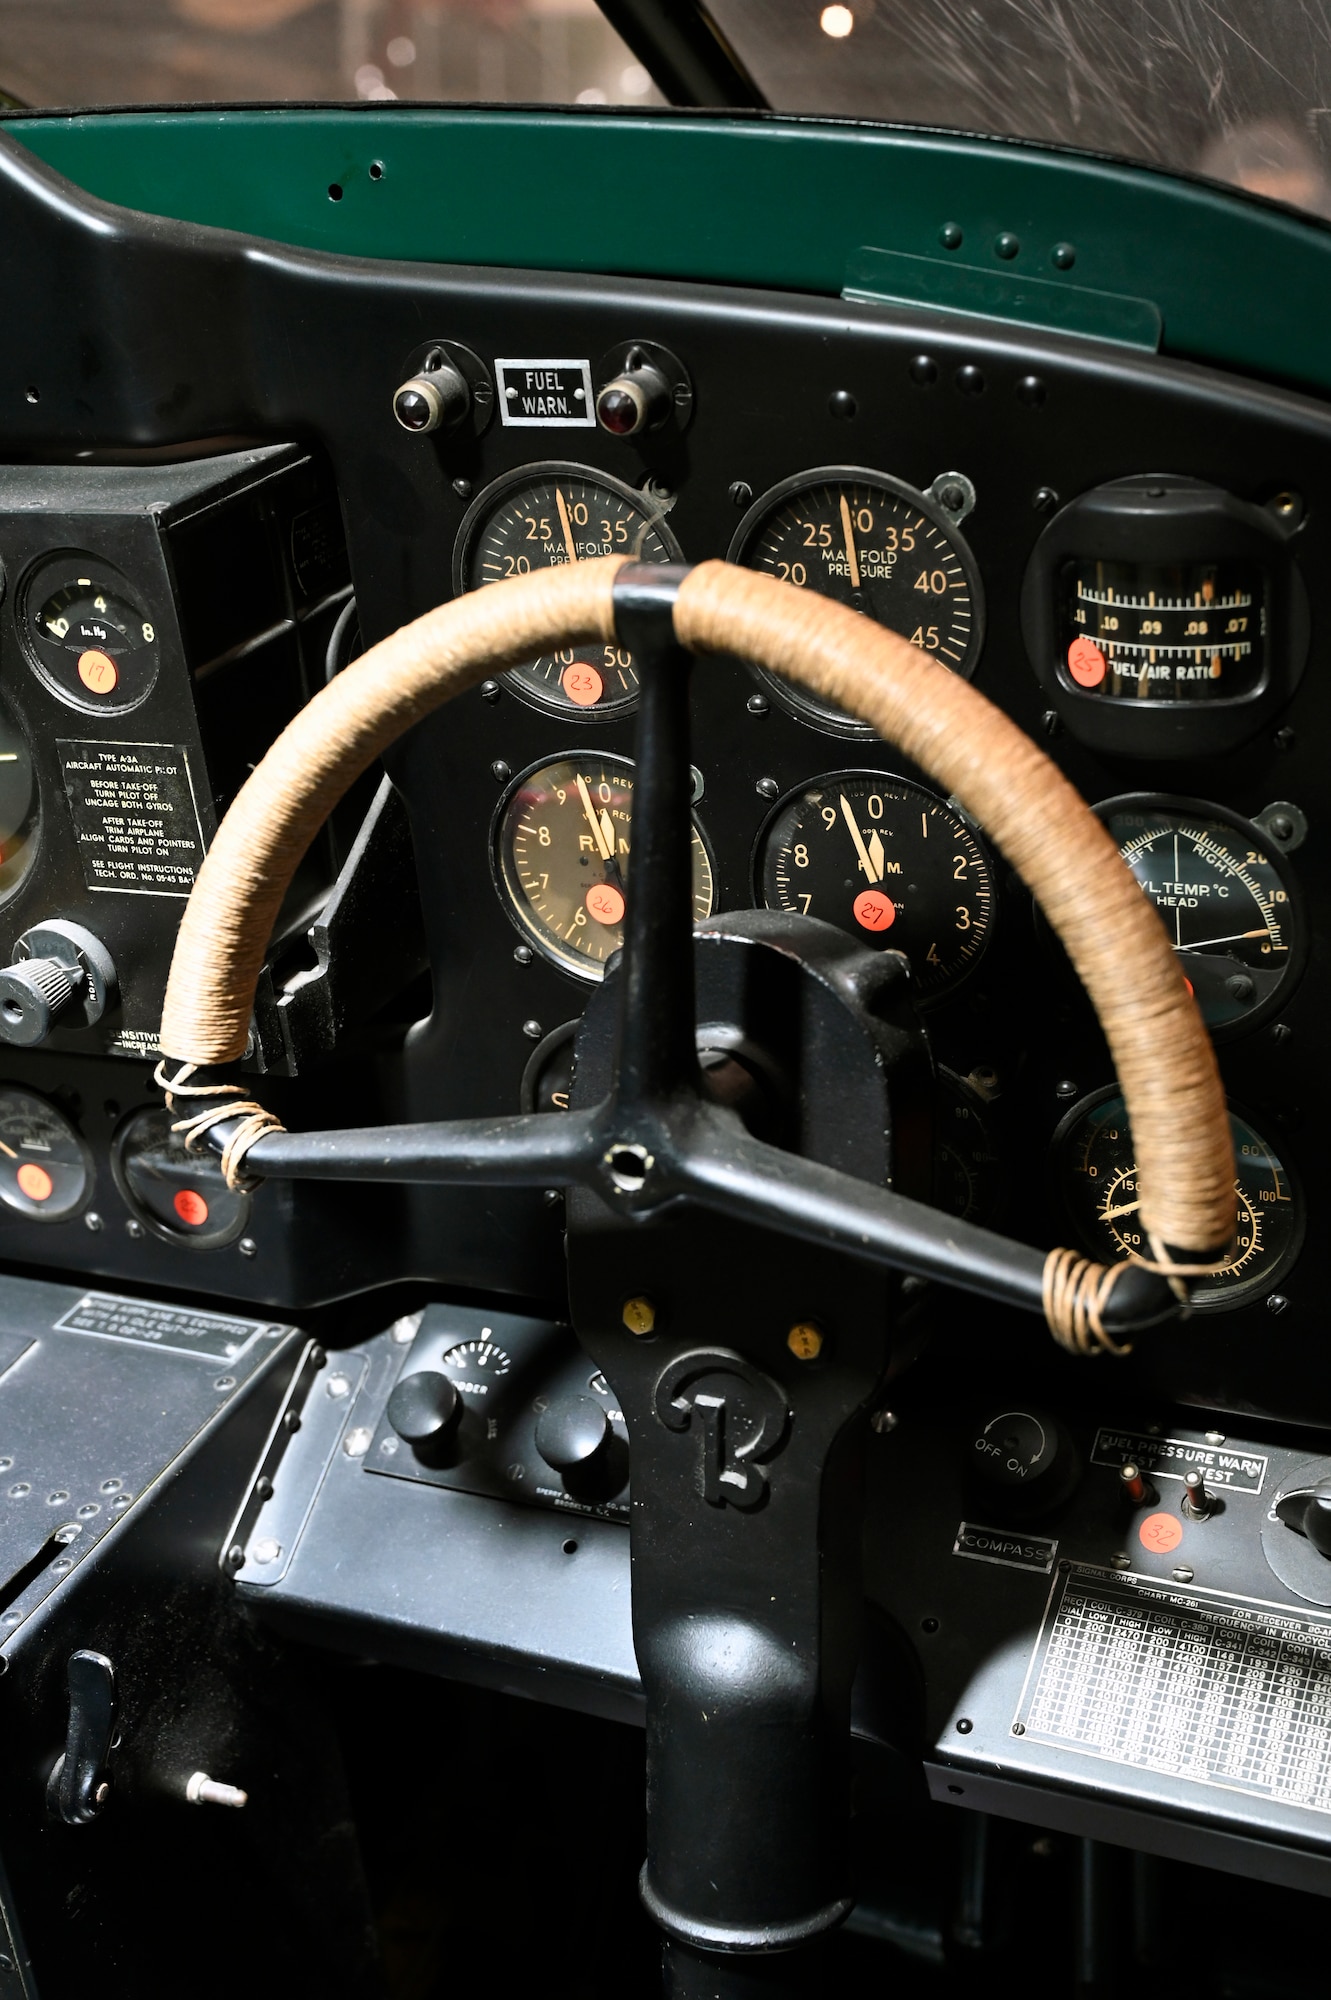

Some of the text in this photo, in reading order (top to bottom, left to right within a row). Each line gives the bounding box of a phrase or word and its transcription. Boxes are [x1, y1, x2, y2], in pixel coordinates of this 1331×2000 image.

[526, 372, 564, 390] FUEL
[522, 397, 572, 415] WARN.
[526, 518, 551, 540] 25
[601, 520, 627, 543] 35
[804, 524, 831, 547] 25
[886, 527, 915, 551] 35
[544, 543, 612, 555] MAIFOLD
[821, 550, 897, 565] MAFOLD
[504, 556, 530, 576] 20
[777, 563, 807, 586] 20
[829, 564, 892, 579] PRESURE
[914, 571, 946, 594] 40
[94, 595, 107, 613] 4
[142, 623, 155, 642] 8
[1139, 621, 1162, 635] .09
[909, 627, 940, 649] 45
[604, 646, 632, 667] 50
[1075, 653, 1099, 671] 25
[89, 662, 104, 682] 17
[571, 675, 592, 690] 23
[98, 754, 116, 762] TYPE
[66, 762, 102, 771] AIRCRAFT
[106, 765, 152, 774] AUTOMATIC
[90, 780, 158, 791] BEFORE TAKE-OFF
[598, 783, 611, 803] 0
[95, 790, 115, 798] TURN
[119, 792, 140, 800] PILOT
[557, 790, 566, 805] 9
[85, 799, 173, 811] UNCAGE BOTH GYROS
[868, 795, 883, 819] 0
[102, 817, 163, 827] AFTER TAKE-OFF
[822, 807, 836, 831] 9
[922, 813, 927, 838] 1
[105, 826, 164, 837] TRIM AIRPLANE
[539, 826, 551, 846] 8
[81, 834, 195, 849] ALIGN CARDS AND POINTERS
[108, 844, 169, 856] TURN PILOT ON
[794, 844, 809, 868] 8
[1192, 844, 1235, 877] RIGHT
[95, 870, 117, 878] TECH.
[120, 871, 138, 879] ORD.
[108, 862, 134, 871] FLIGHT
[138, 864, 193, 875] INSTRUCTIONS
[953, 856, 967, 880] 2
[540, 874, 548, 889] 7
[593, 896, 612, 913] 26
[798, 894, 812, 915] 7
[1157, 896, 1198, 907] HEAD
[574, 907, 586, 926] 6
[862, 903, 883, 924] 27
[956, 907, 970, 929] 3
[926, 943, 940, 965] 4
[1261, 943, 1271, 953] 0
[1242, 1145, 1259, 1156] 80
[1088, 1166, 1098, 1177] 0
[1259, 1191, 1276, 1203] 100
[1237, 1211, 1250, 1223] 15
[1123, 1233, 1141, 1246] 50
[1237, 1236, 1249, 1247] 10
[975, 1439, 1002, 1456] OFF
[1100, 1435, 1262, 1475] FUEL PRESSURE WARN
[1007, 1458, 1028, 1477] ON
[1120, 1453, 1157, 1468] TEST
[1197, 1466, 1234, 1482] TEST
[1148, 1524, 1174, 1546] 32
[965, 1535, 1045, 1560] COMPASS
[1077, 1566, 1138, 1584] SIGNAL CORPS
[1061, 1605, 1082, 1616] DIAL
[1091, 1601, 1143, 1619] COIL C-379
[1138, 1590, 1167, 1601] CHART
[1170, 1595, 1198, 1608] MC-261
[1232, 1610, 1251, 1619] FOR
[1257, 1615, 1301, 1630] RECEIVER
[1088, 1611, 1206, 1643] LOW HIGH LOW HIGH
[1154, 1615, 1209, 1633] COIL C-380
[1200, 1613, 1261, 1632] FREQUENCY
[1266, 1627, 1276, 1636] IN
[1215, 1638, 1242, 1650] C-341
[1220, 1630, 1243, 1641] COIL
[1253, 1637, 1276, 1648] COIL
[1085, 1622, 1105, 1632] 200
[1114, 1628, 1140, 1640] 2470
[1149, 1636, 1169, 1647] 200
[1180, 1642, 1206, 1655] 4100
[1249, 1658, 1269, 1668] 193
[1282, 1665, 1302, 1676] 390
[1248, 1646, 1277, 1658] C-342
[1287, 1644, 1309, 1655] COIL
[1281, 1653, 1310, 1665] C-343
[1177, 1653, 1300, 1687] 4400 157 209 420
